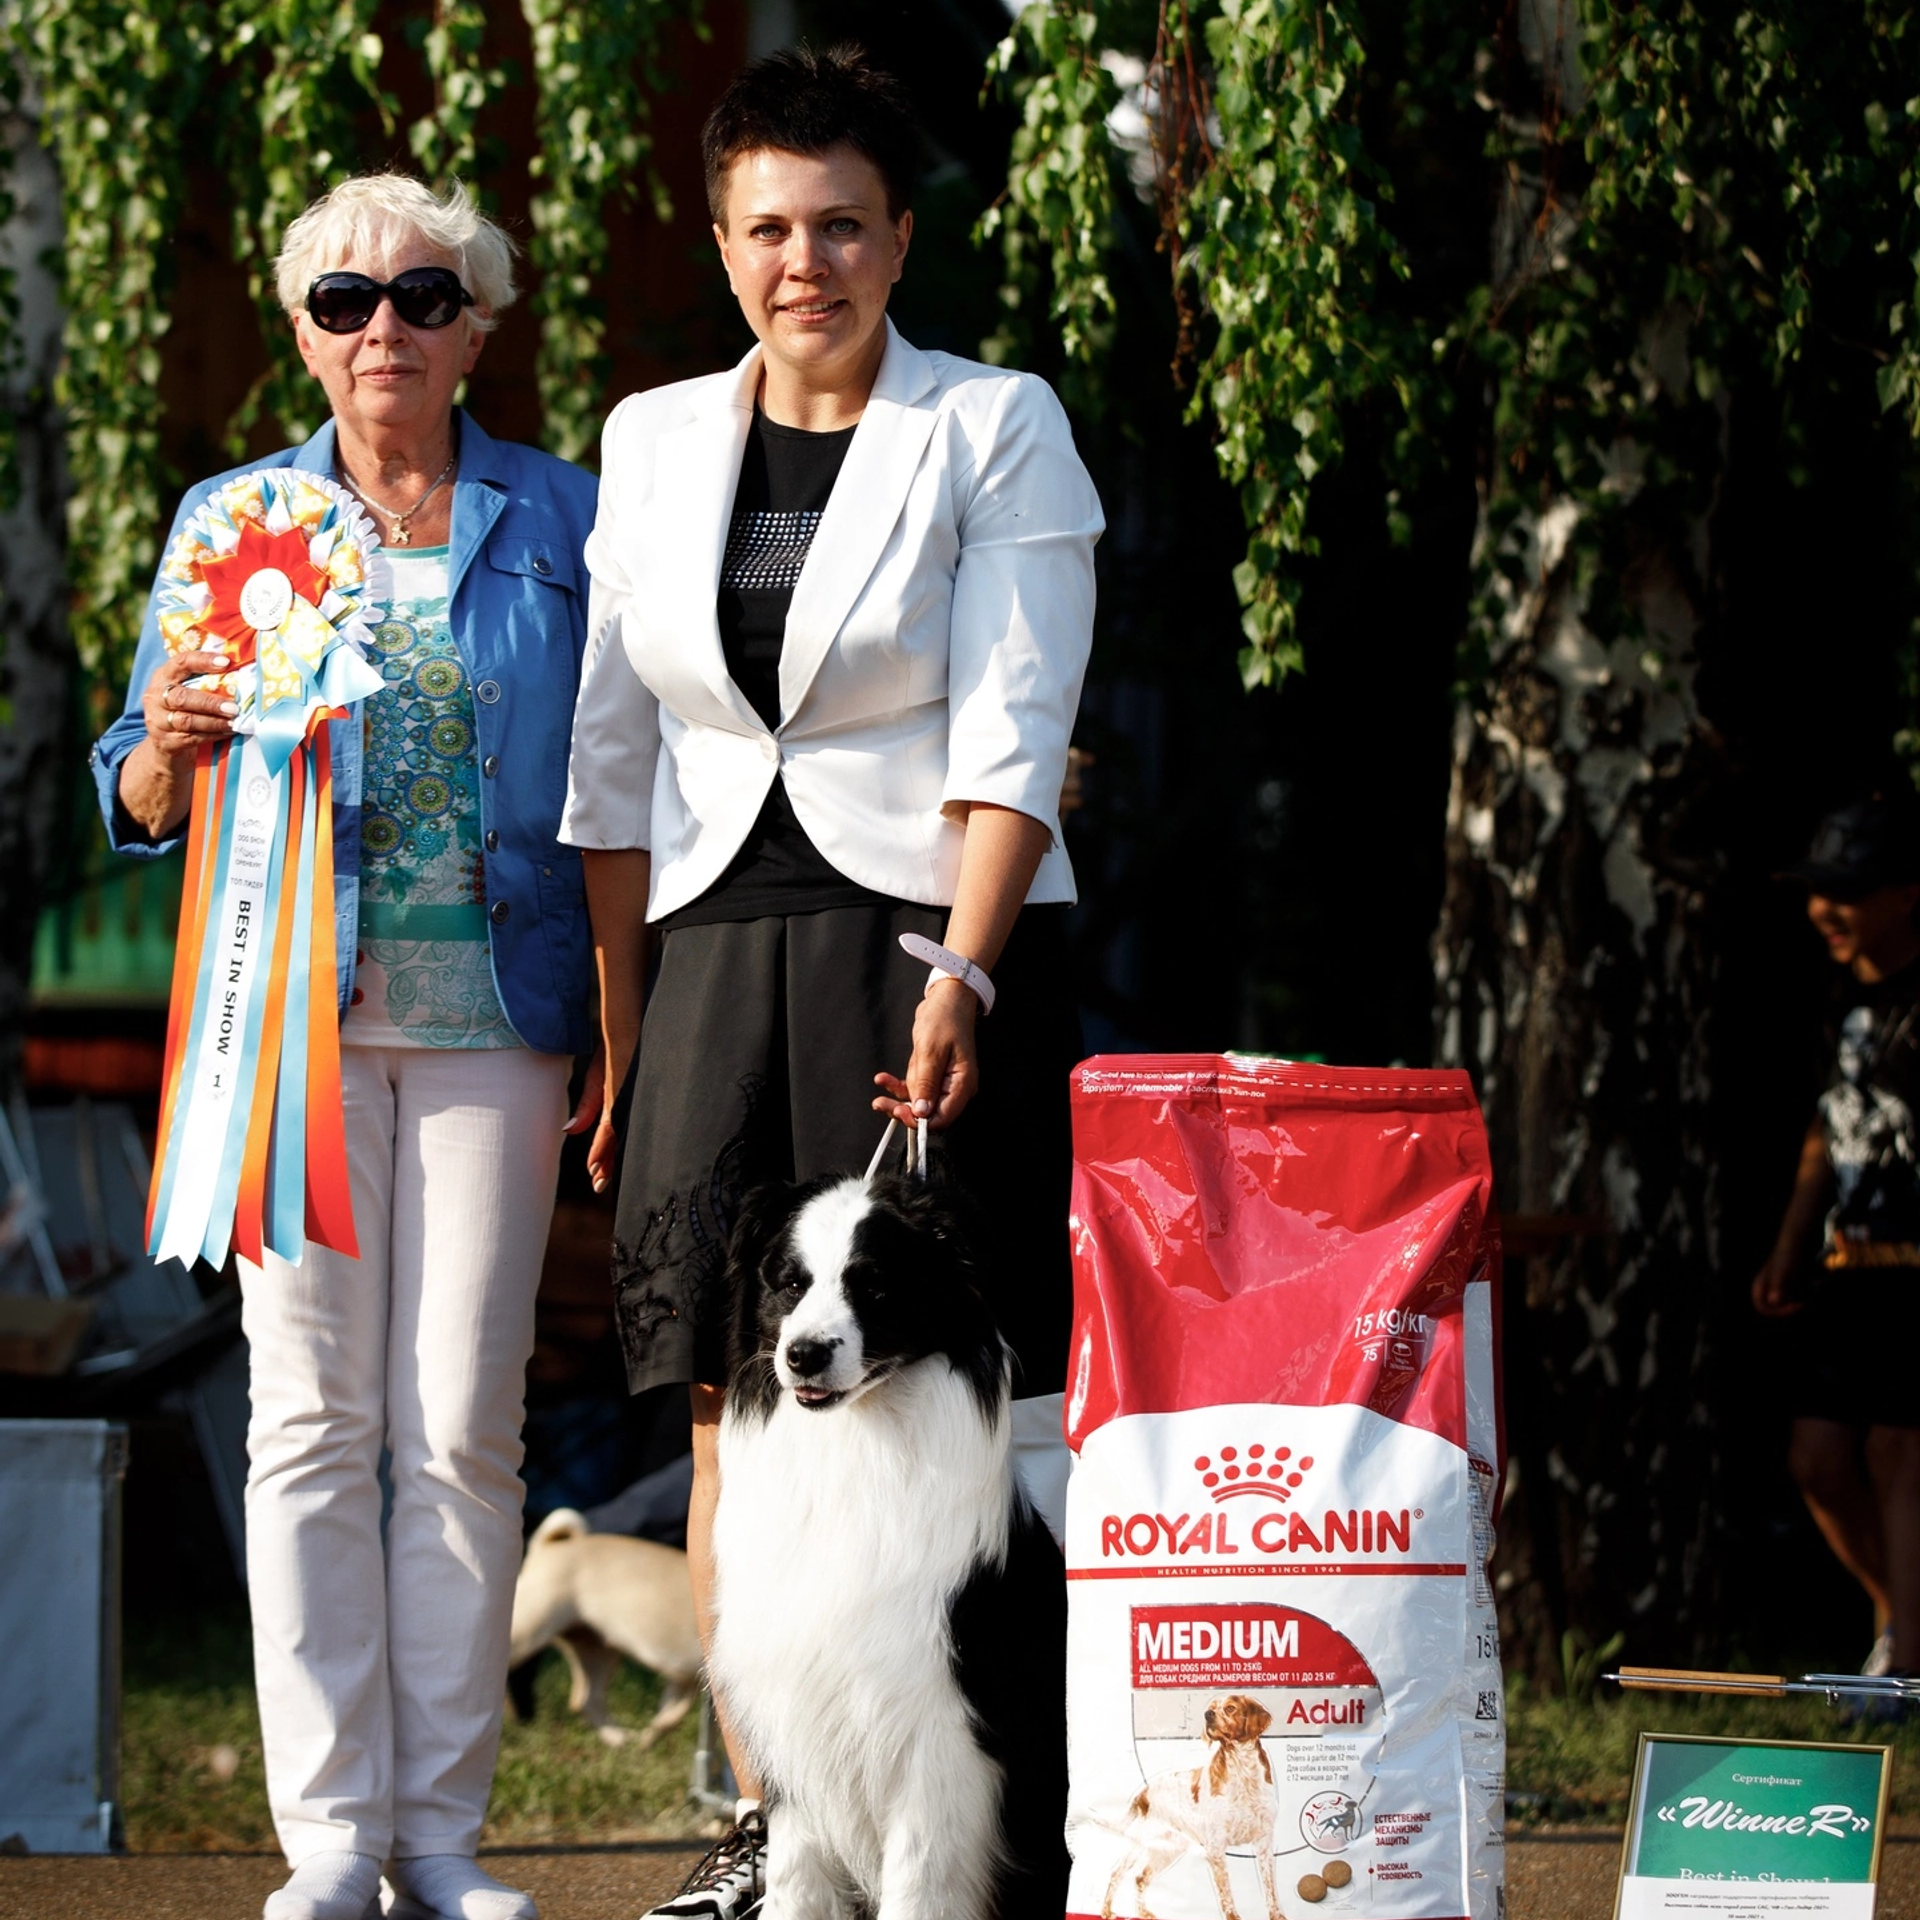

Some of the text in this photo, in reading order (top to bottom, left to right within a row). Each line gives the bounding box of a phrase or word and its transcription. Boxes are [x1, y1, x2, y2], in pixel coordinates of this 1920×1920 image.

[230, 877, 264, 889] ТОП ЛИДЕР
[213, 900, 252, 1088] BEST IN SHOW 1
[1082, 1084, 1124, 1093] zipsystem
[1132, 1083, 1183, 1092] refermable
[1354, 1313, 1374, 1339] 15
[1362, 1348, 1378, 1362] 75
[1102, 1512, 1239, 1557] ROYAL
[1203, 1567, 1265, 1575] NUTRITION
[1272, 1566, 1306, 1574] SINCE
[1138, 1620, 1299, 1660] MEDIUM
[1139, 1662, 1262, 1673] ALL MEDIUM DOGS FROM 11 TO 25KG
[1139, 1672, 1336, 1684] ДЛЯ СОБАК СРЕДНИХ РАЗМЕРОВ ВЕСОМ ОТ 11 ДО 25 КГ
[1286, 1699, 1366, 1724] Adult
[1286, 1744, 1301, 1753] Dogs
[1300, 1764, 1316, 1772] собак
[1732, 1772, 1803, 1788] Сертификат
[1374, 1812, 1431, 1824] ЕСТЕСТВЕННЫЕ
[1375, 1824, 1423, 1834] МЕХАНИЗМЫ
[1375, 1836, 1409, 1846] ЗАЩИТЫ
[1377, 1862, 1408, 1871] ВЫСОКАЯ
[1377, 1871, 1423, 1880] УСВОЯЕМОСТЬ
